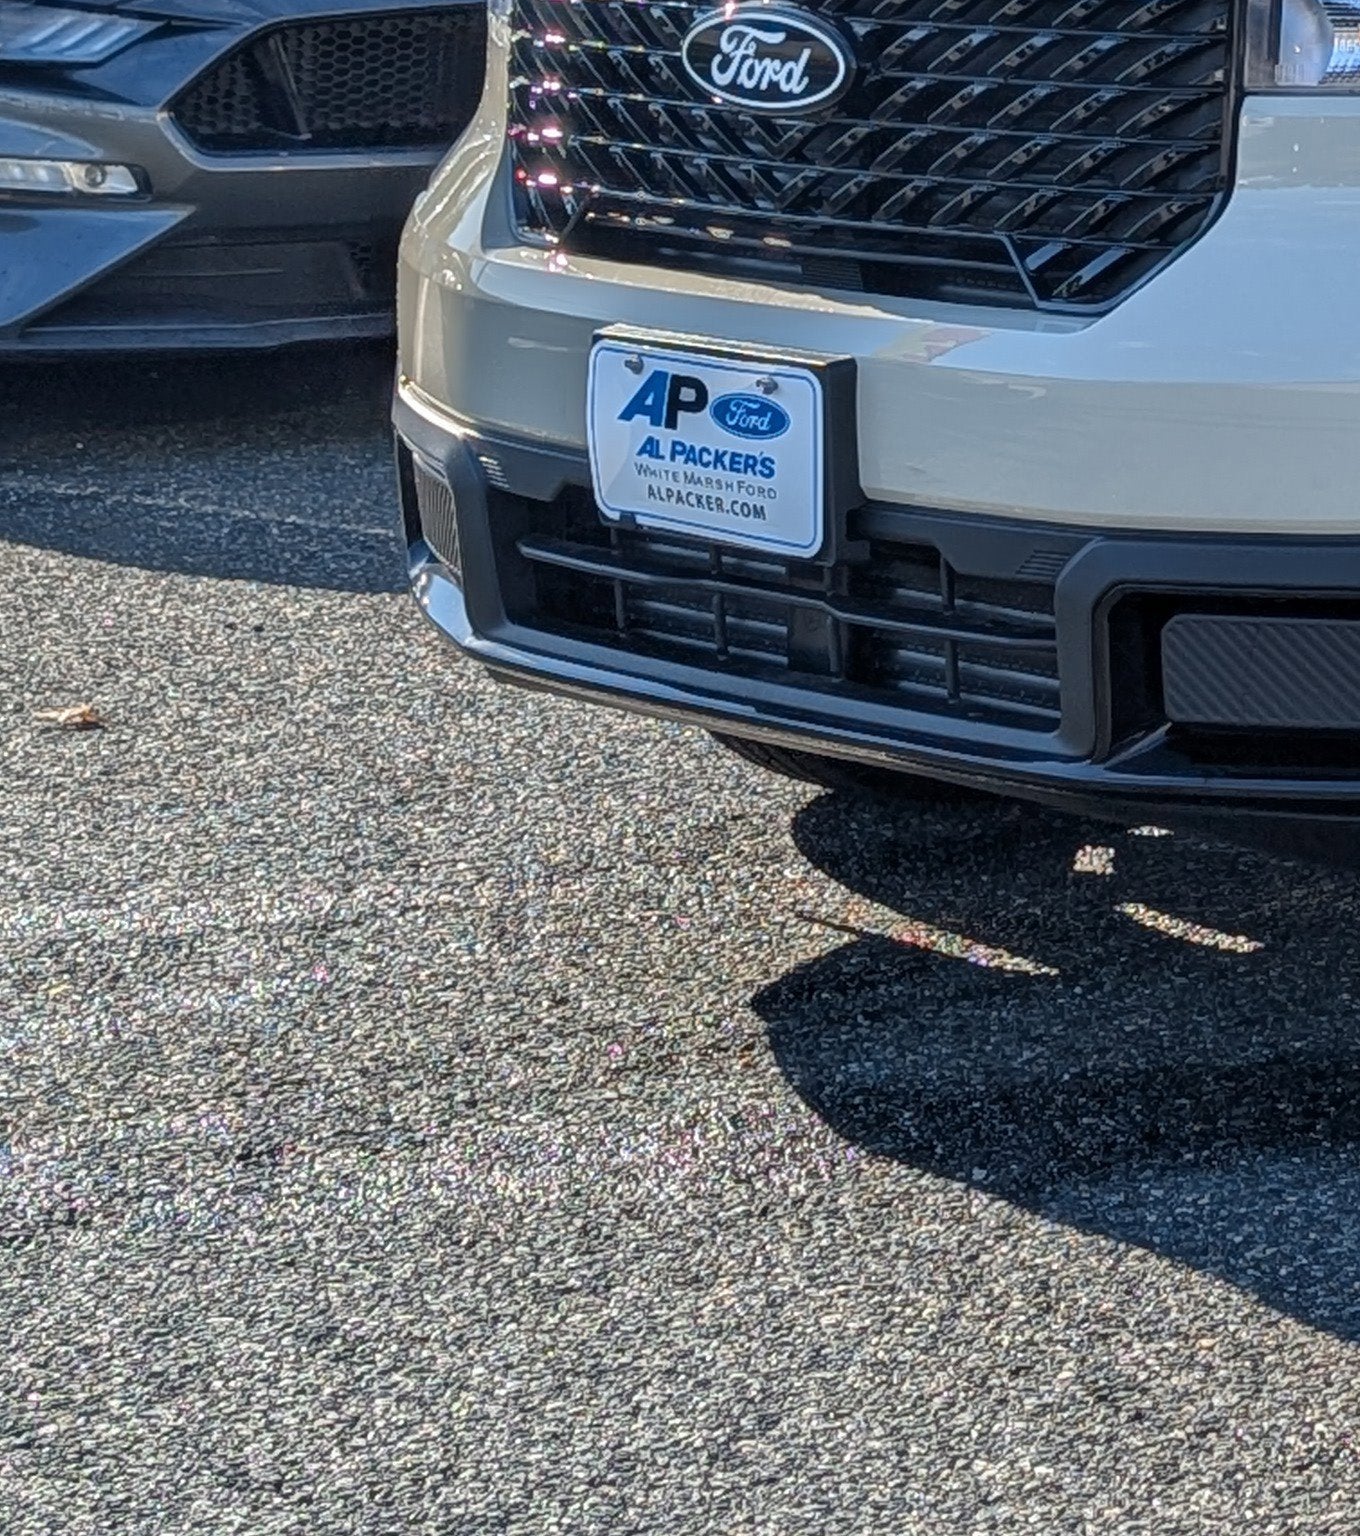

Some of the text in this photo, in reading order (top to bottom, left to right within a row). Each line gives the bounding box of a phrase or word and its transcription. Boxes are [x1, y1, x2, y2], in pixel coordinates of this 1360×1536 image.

[711, 24, 811, 94] Ford
[617, 370, 709, 431] AP
[724, 399, 773, 432] Ford
[636, 435, 777, 479] AL PACKER'S
[634, 462, 778, 501] WHITE MARSH FORD
[647, 484, 768, 521] ALPACKER.COM
